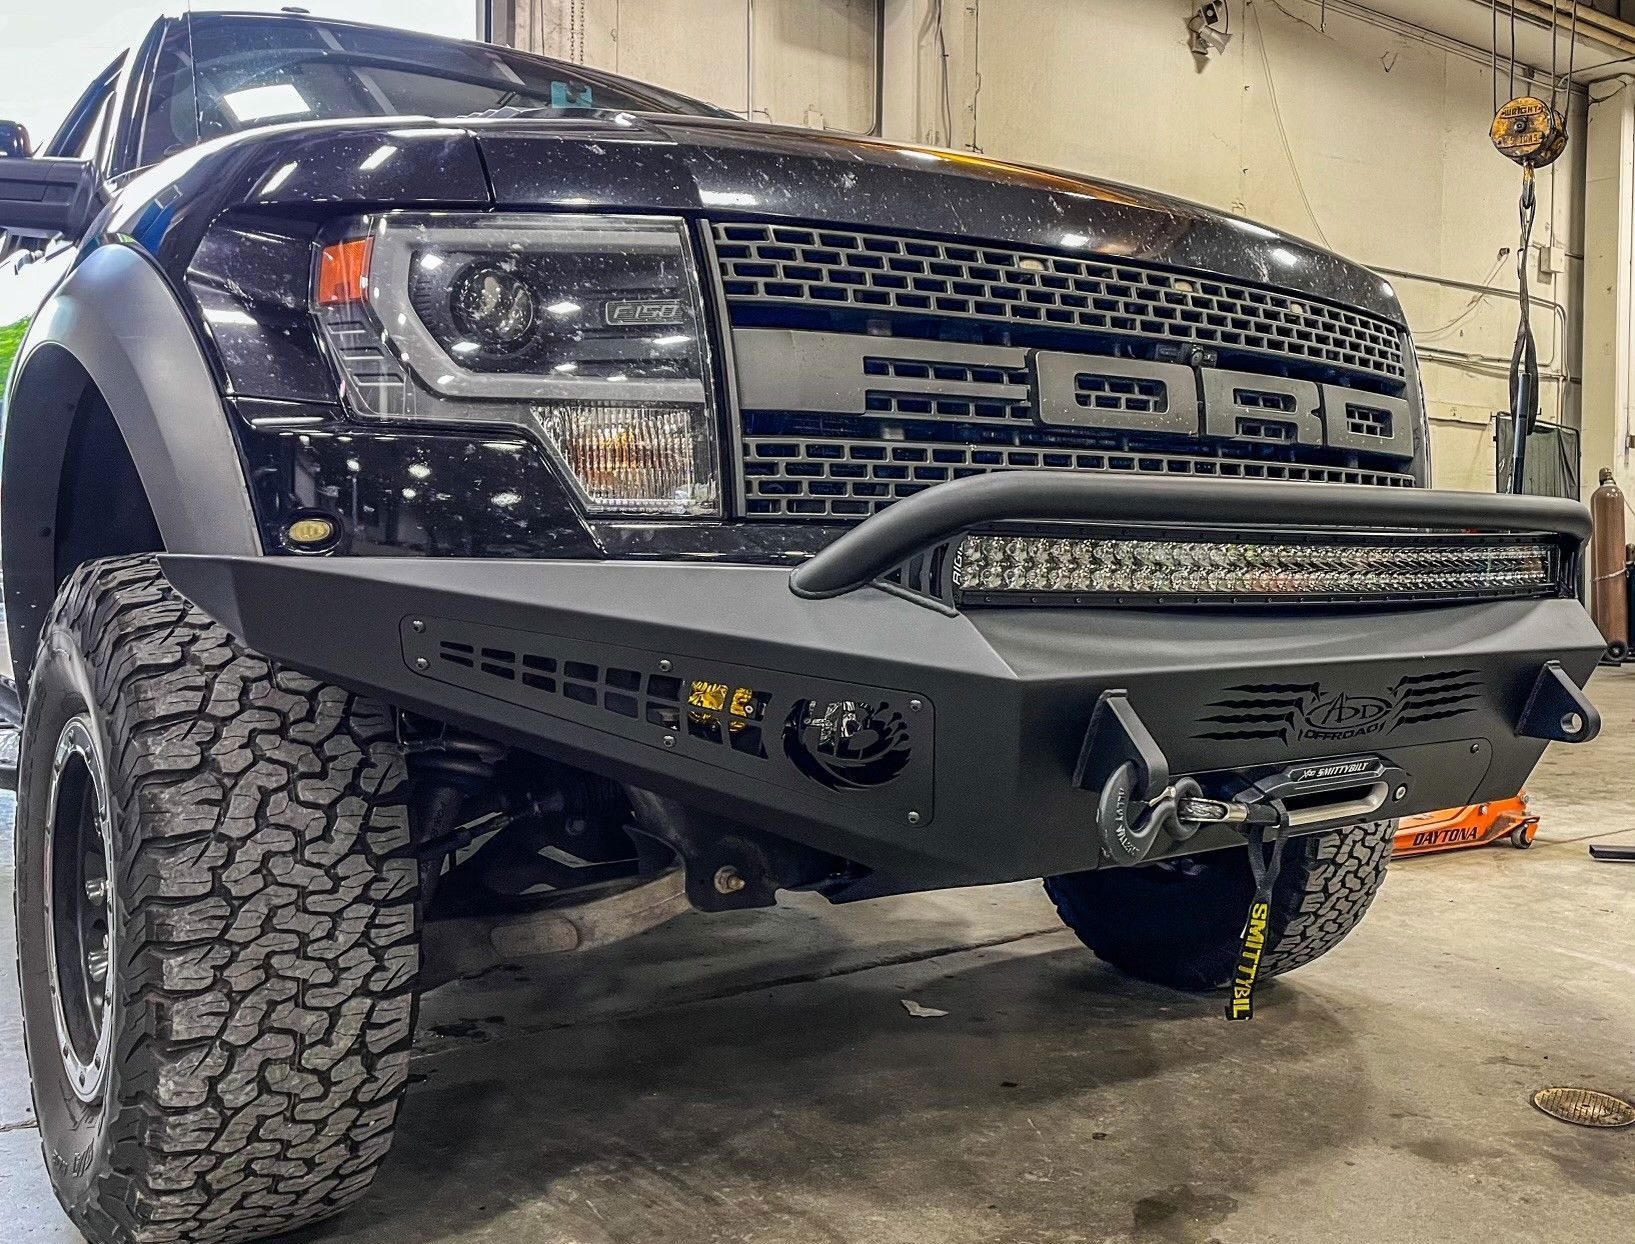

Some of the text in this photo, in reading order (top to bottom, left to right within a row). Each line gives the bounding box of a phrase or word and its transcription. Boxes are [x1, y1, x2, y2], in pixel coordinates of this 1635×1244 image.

[1504, 105, 1538, 117] WRIGHT
[732, 328, 1414, 457] FORD
[1303, 722, 1380, 741] OFFROAD
[1316, 762, 1369, 777] SMITTYBILT
[1413, 826, 1478, 846] DAYTONA
[1231, 902, 1269, 1021] SMITTYBIL
